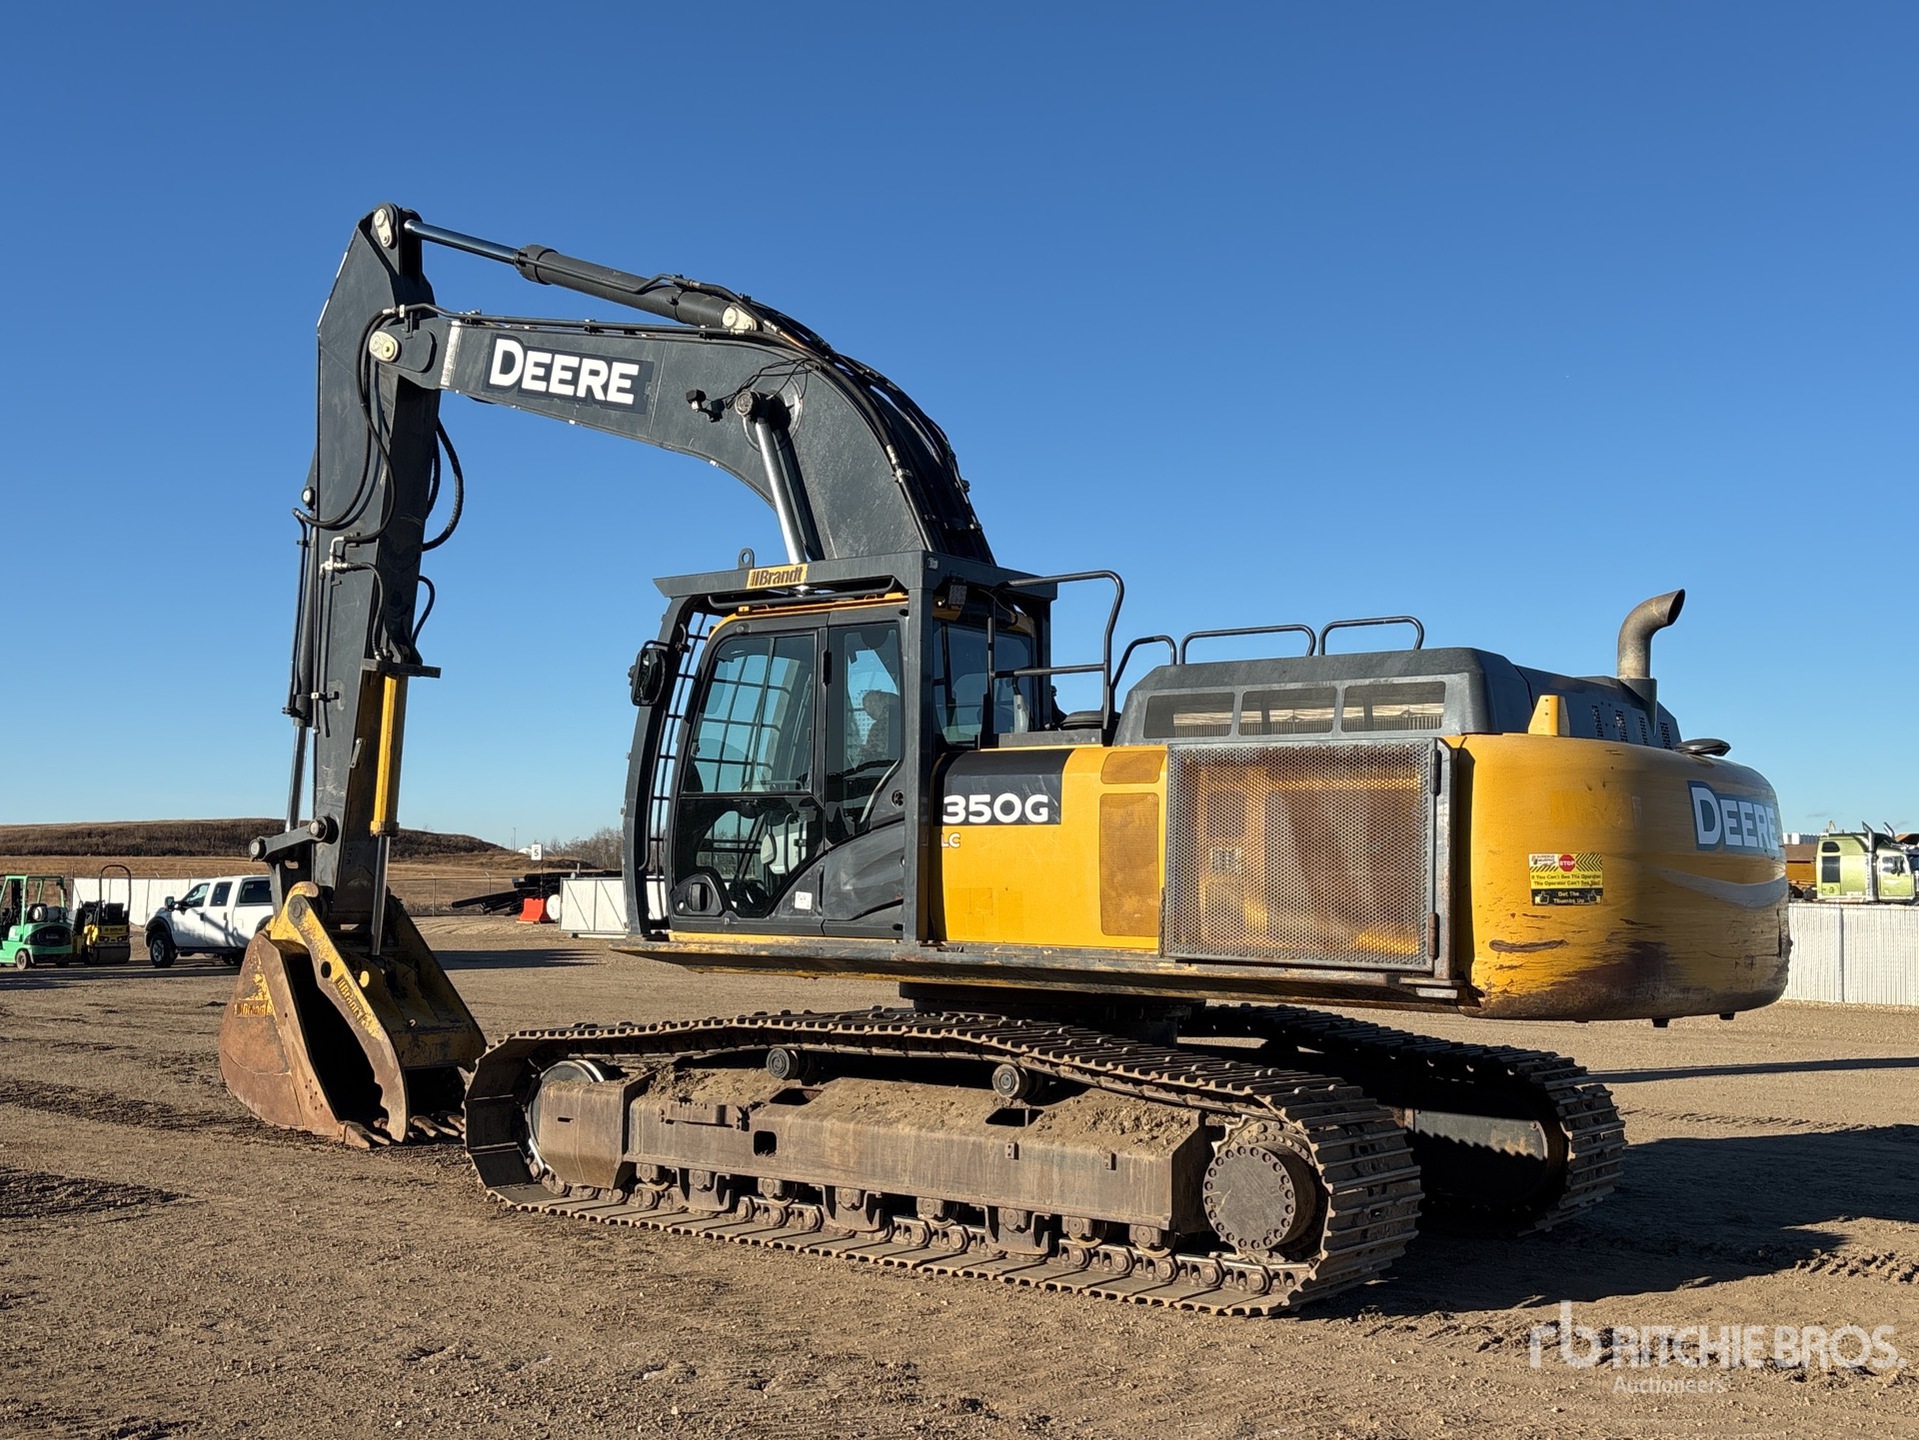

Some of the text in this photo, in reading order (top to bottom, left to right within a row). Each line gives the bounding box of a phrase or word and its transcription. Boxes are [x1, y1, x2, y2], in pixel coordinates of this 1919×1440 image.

[489, 338, 640, 405] DEERE
[942, 793, 1049, 824] 350G
[1691, 787, 1779, 852] DEERE
[534, 849, 539, 857] 5
[941, 832, 960, 848] LC
